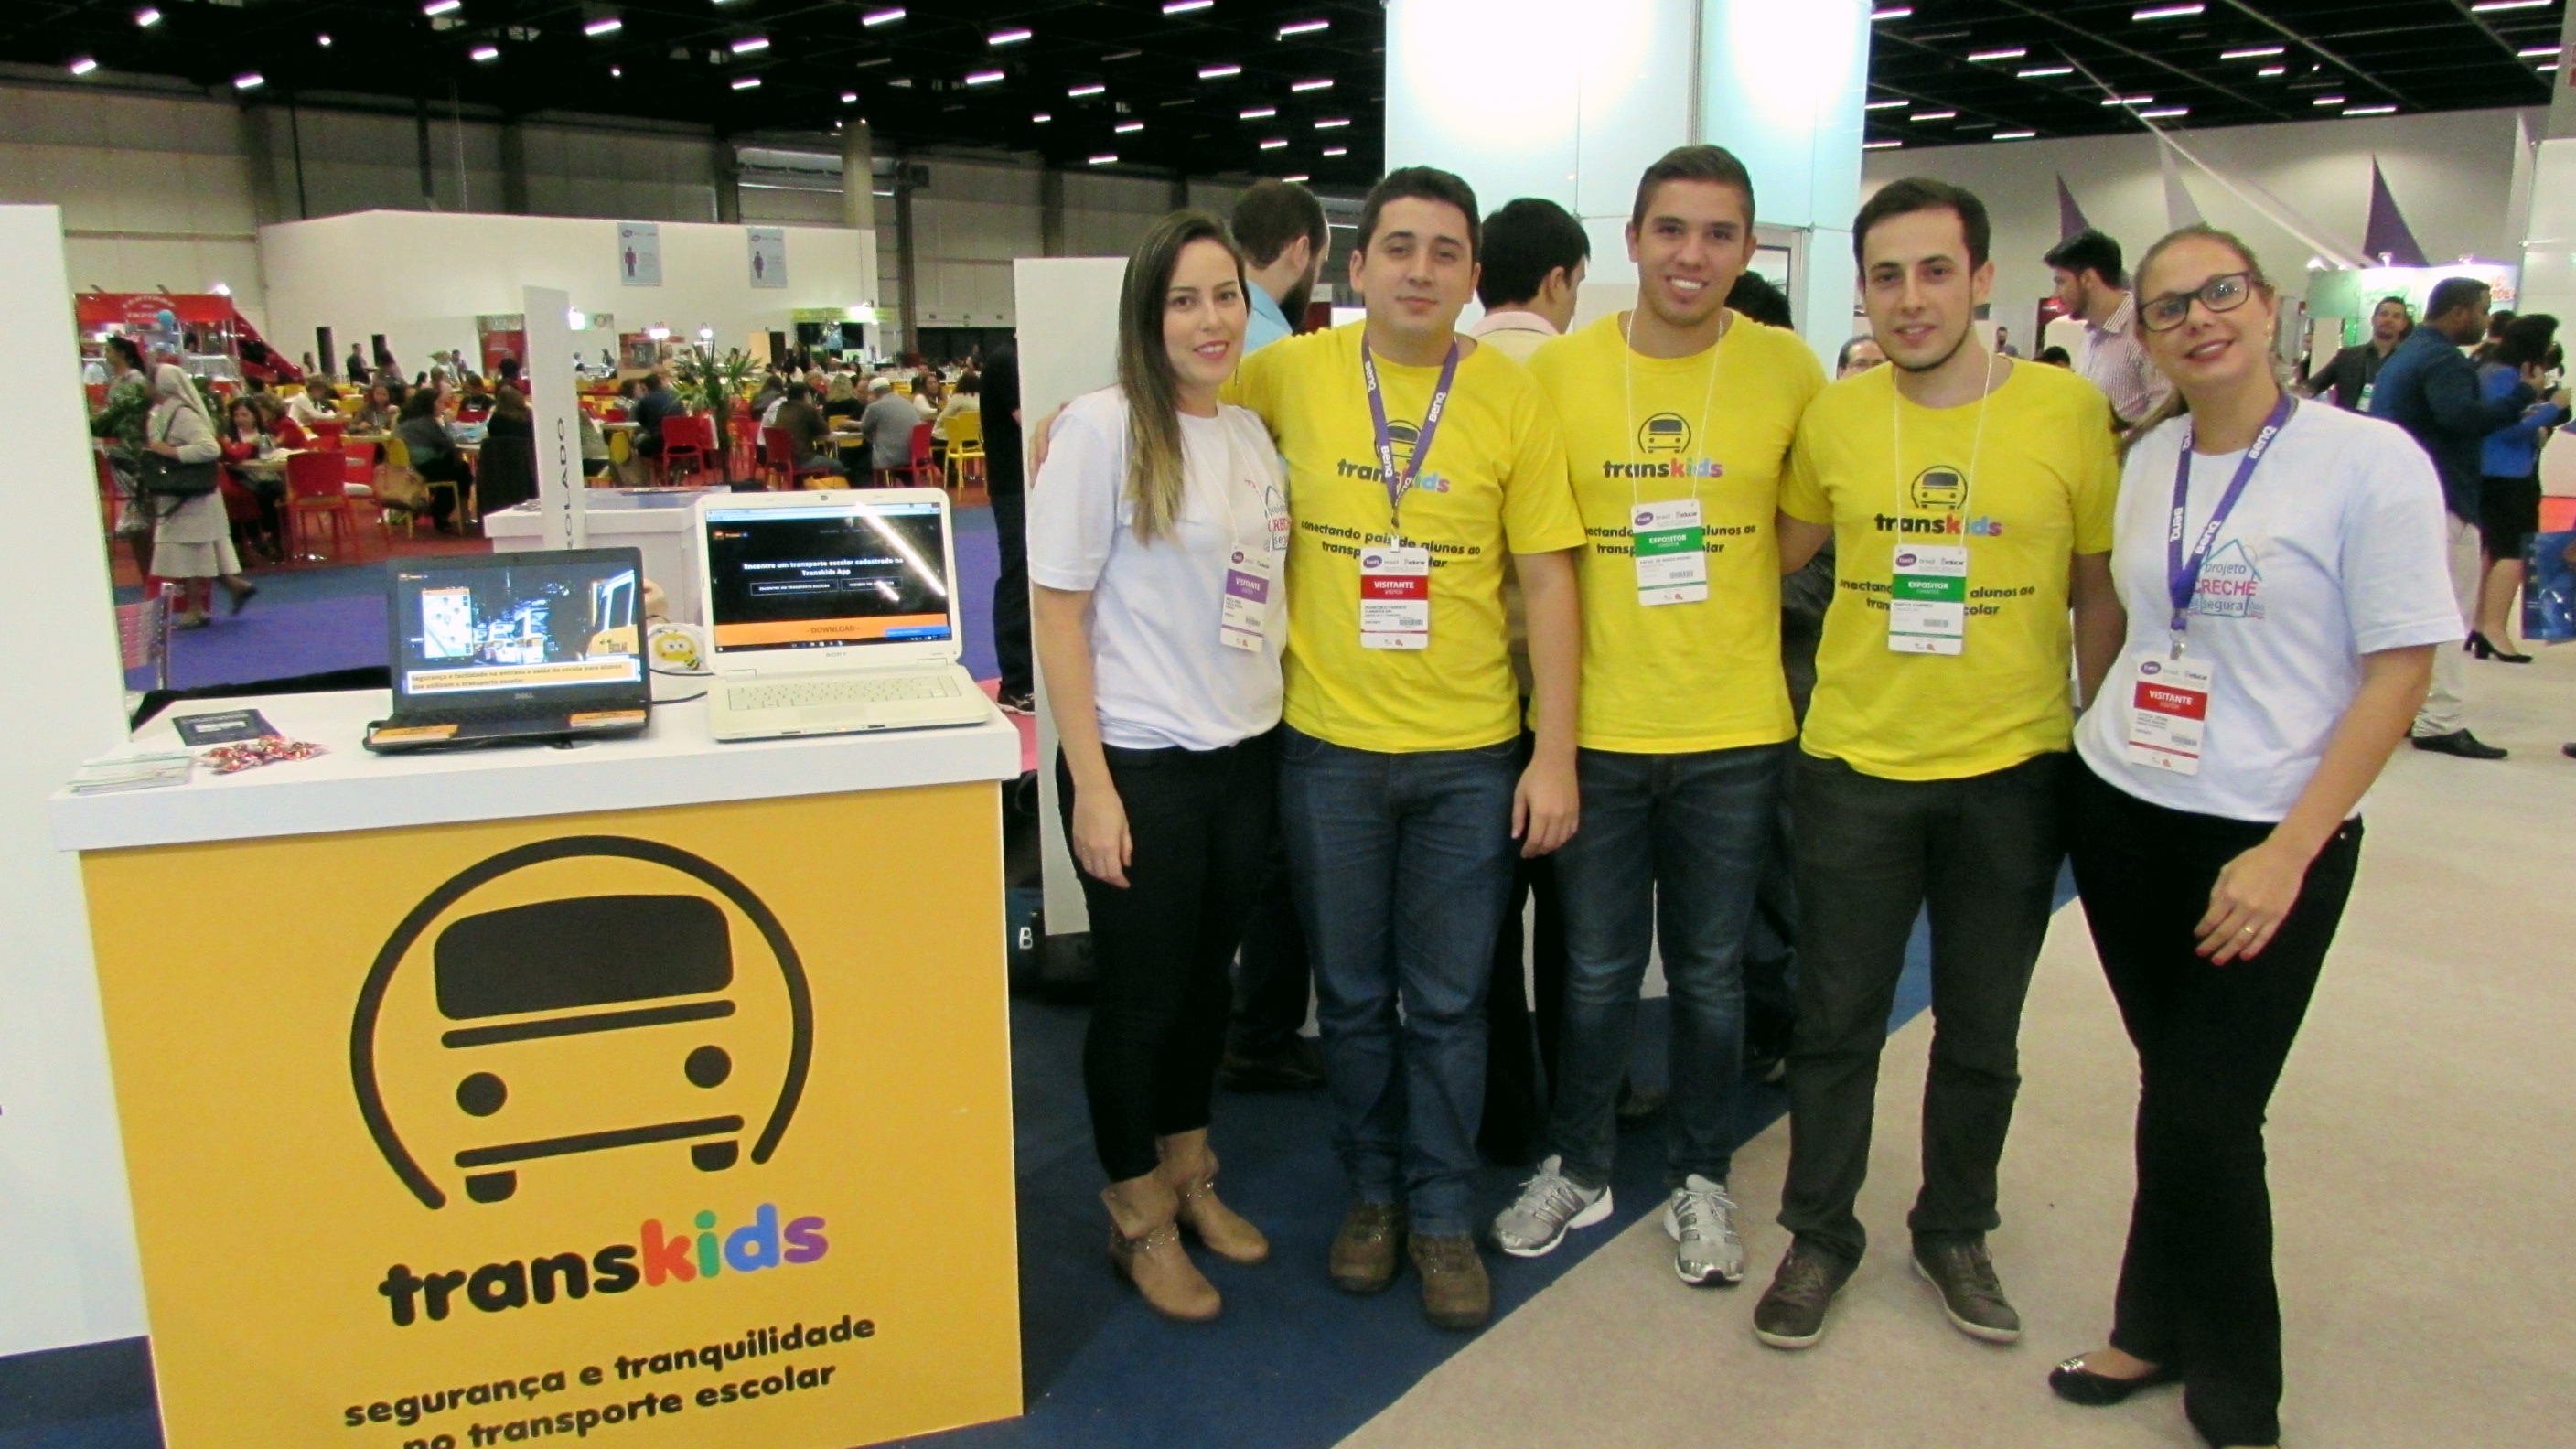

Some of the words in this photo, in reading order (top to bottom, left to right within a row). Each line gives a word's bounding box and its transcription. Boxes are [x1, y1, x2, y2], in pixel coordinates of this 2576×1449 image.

[1365, 360, 1376, 392] BenQ
[1429, 392, 1447, 423] BenQ
[2248, 425, 2277, 459] BenQ
[1381, 445, 1393, 478] BenQ
[1603, 457, 1723, 478] transkids
[1744, 525, 1756, 534] ao
[2169, 507, 2184, 542] BenQ
[1301, 520, 1361, 540] conectando
[1399, 537, 1415, 549] de
[1421, 539, 1464, 554] alunos
[1467, 546, 1481, 555] ao
[1649, 534, 1687, 544] EXPOSITOR
[2195, 520, 2223, 554] BenQ
[789, 561, 828, 569] transporte
[829, 559, 853, 567] escolar
[855, 557, 894, 565] cadastrado
[802, 568, 836, 576] Transkids
[837, 568, 851, 576] App
[2204, 562, 2247, 575] projeto
[1374, 581, 1415, 589] VISITANTE
[1907, 581, 1949, 590] EXPOSITOR
[1970, 586, 2017, 598] alunos
[2020, 585, 2035, 596] ao
[2194, 578, 2258, 596] CRECHE
[2202, 600, 2244, 612] segura
[810, 625, 855, 634] DOWNLOAD
[2149, 690, 2193, 705] VISITANTE
[1019, 927, 1033, 950] B
[379, 1202, 829, 1326] transkids
[345, 1370, 566, 1427] segurança
[579, 1366, 604, 1386] e
[614, 1315, 875, 1379] tranquilidade
[467, 1392, 683, 1448] transporte
[695, 1364, 836, 1407] escolar
